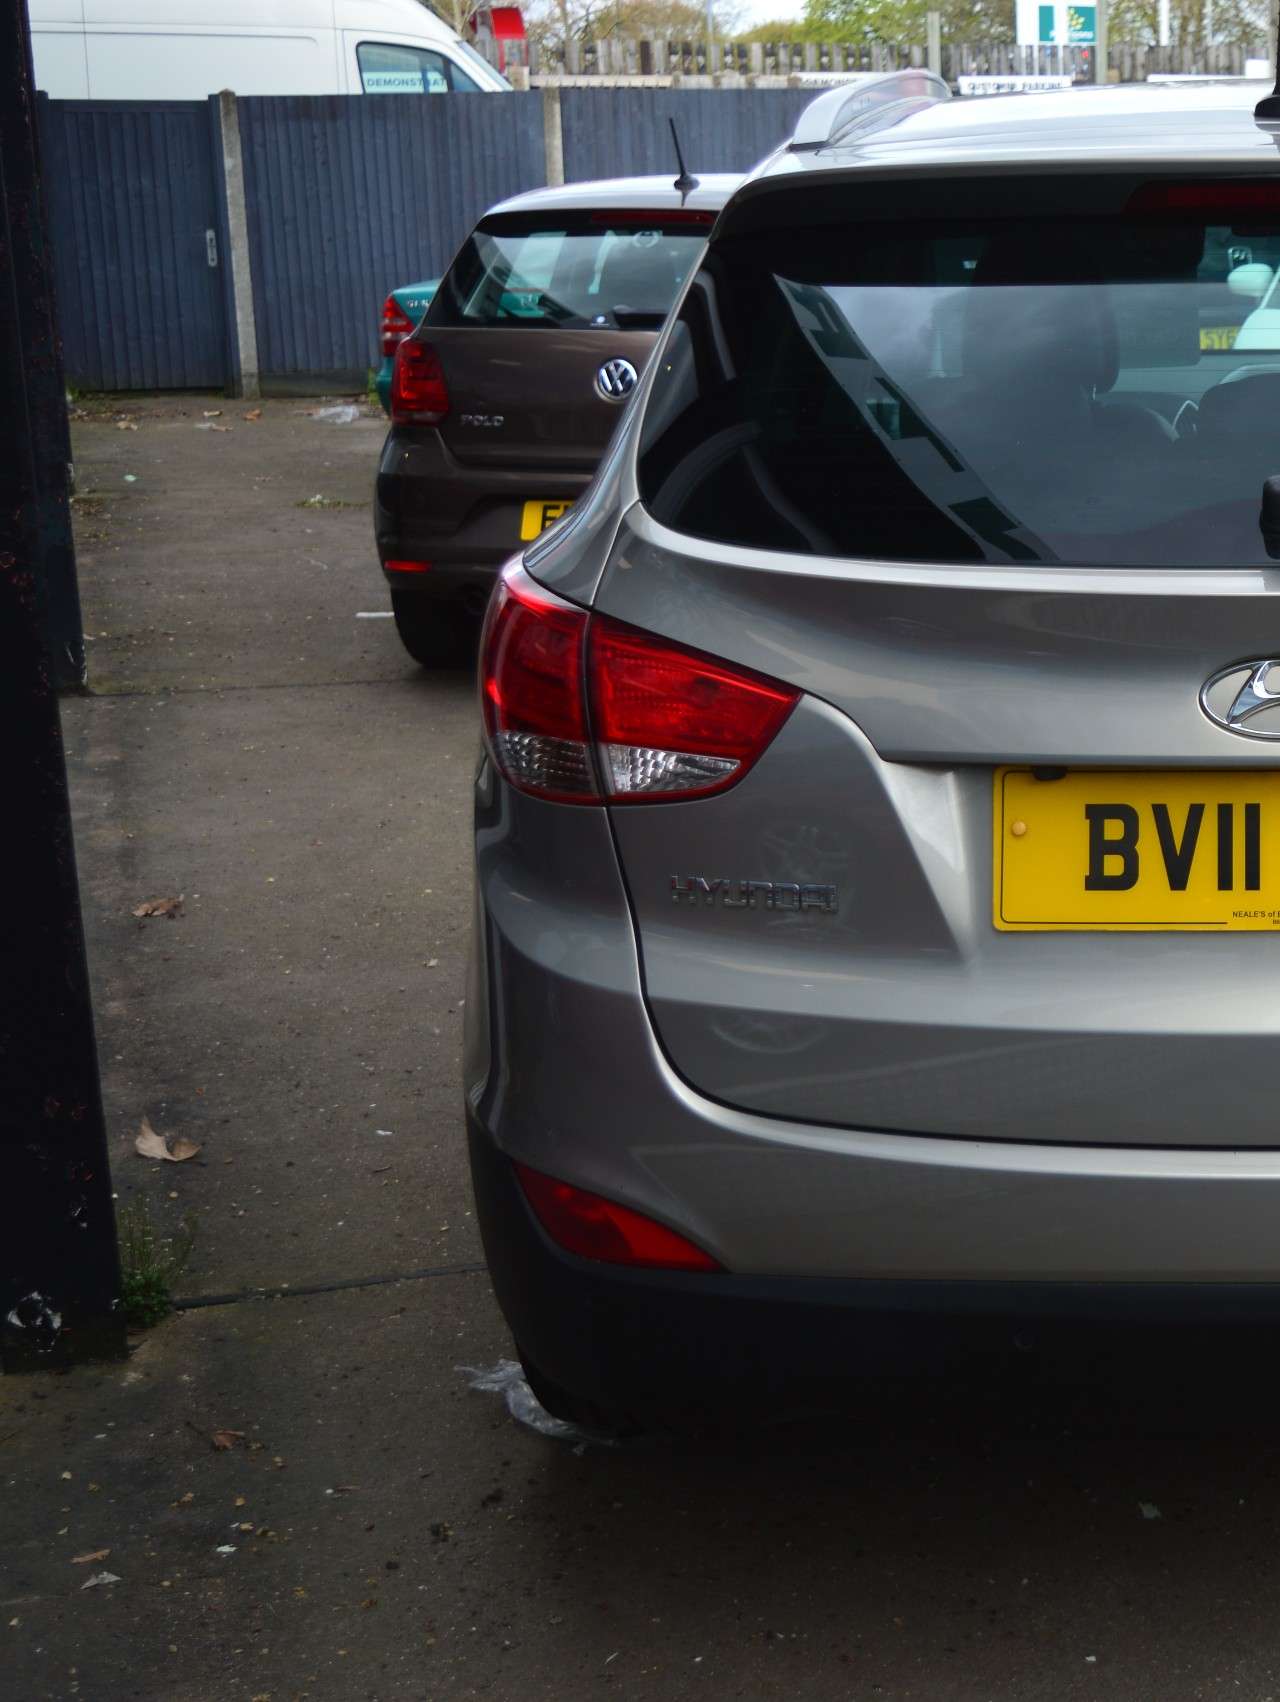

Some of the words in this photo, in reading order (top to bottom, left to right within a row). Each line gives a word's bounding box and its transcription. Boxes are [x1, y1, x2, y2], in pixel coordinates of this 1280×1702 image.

[460, 414, 505, 427] POLO
[1084, 803, 1261, 892] BV11
[1232, 910, 1266, 918] NEALE'S
